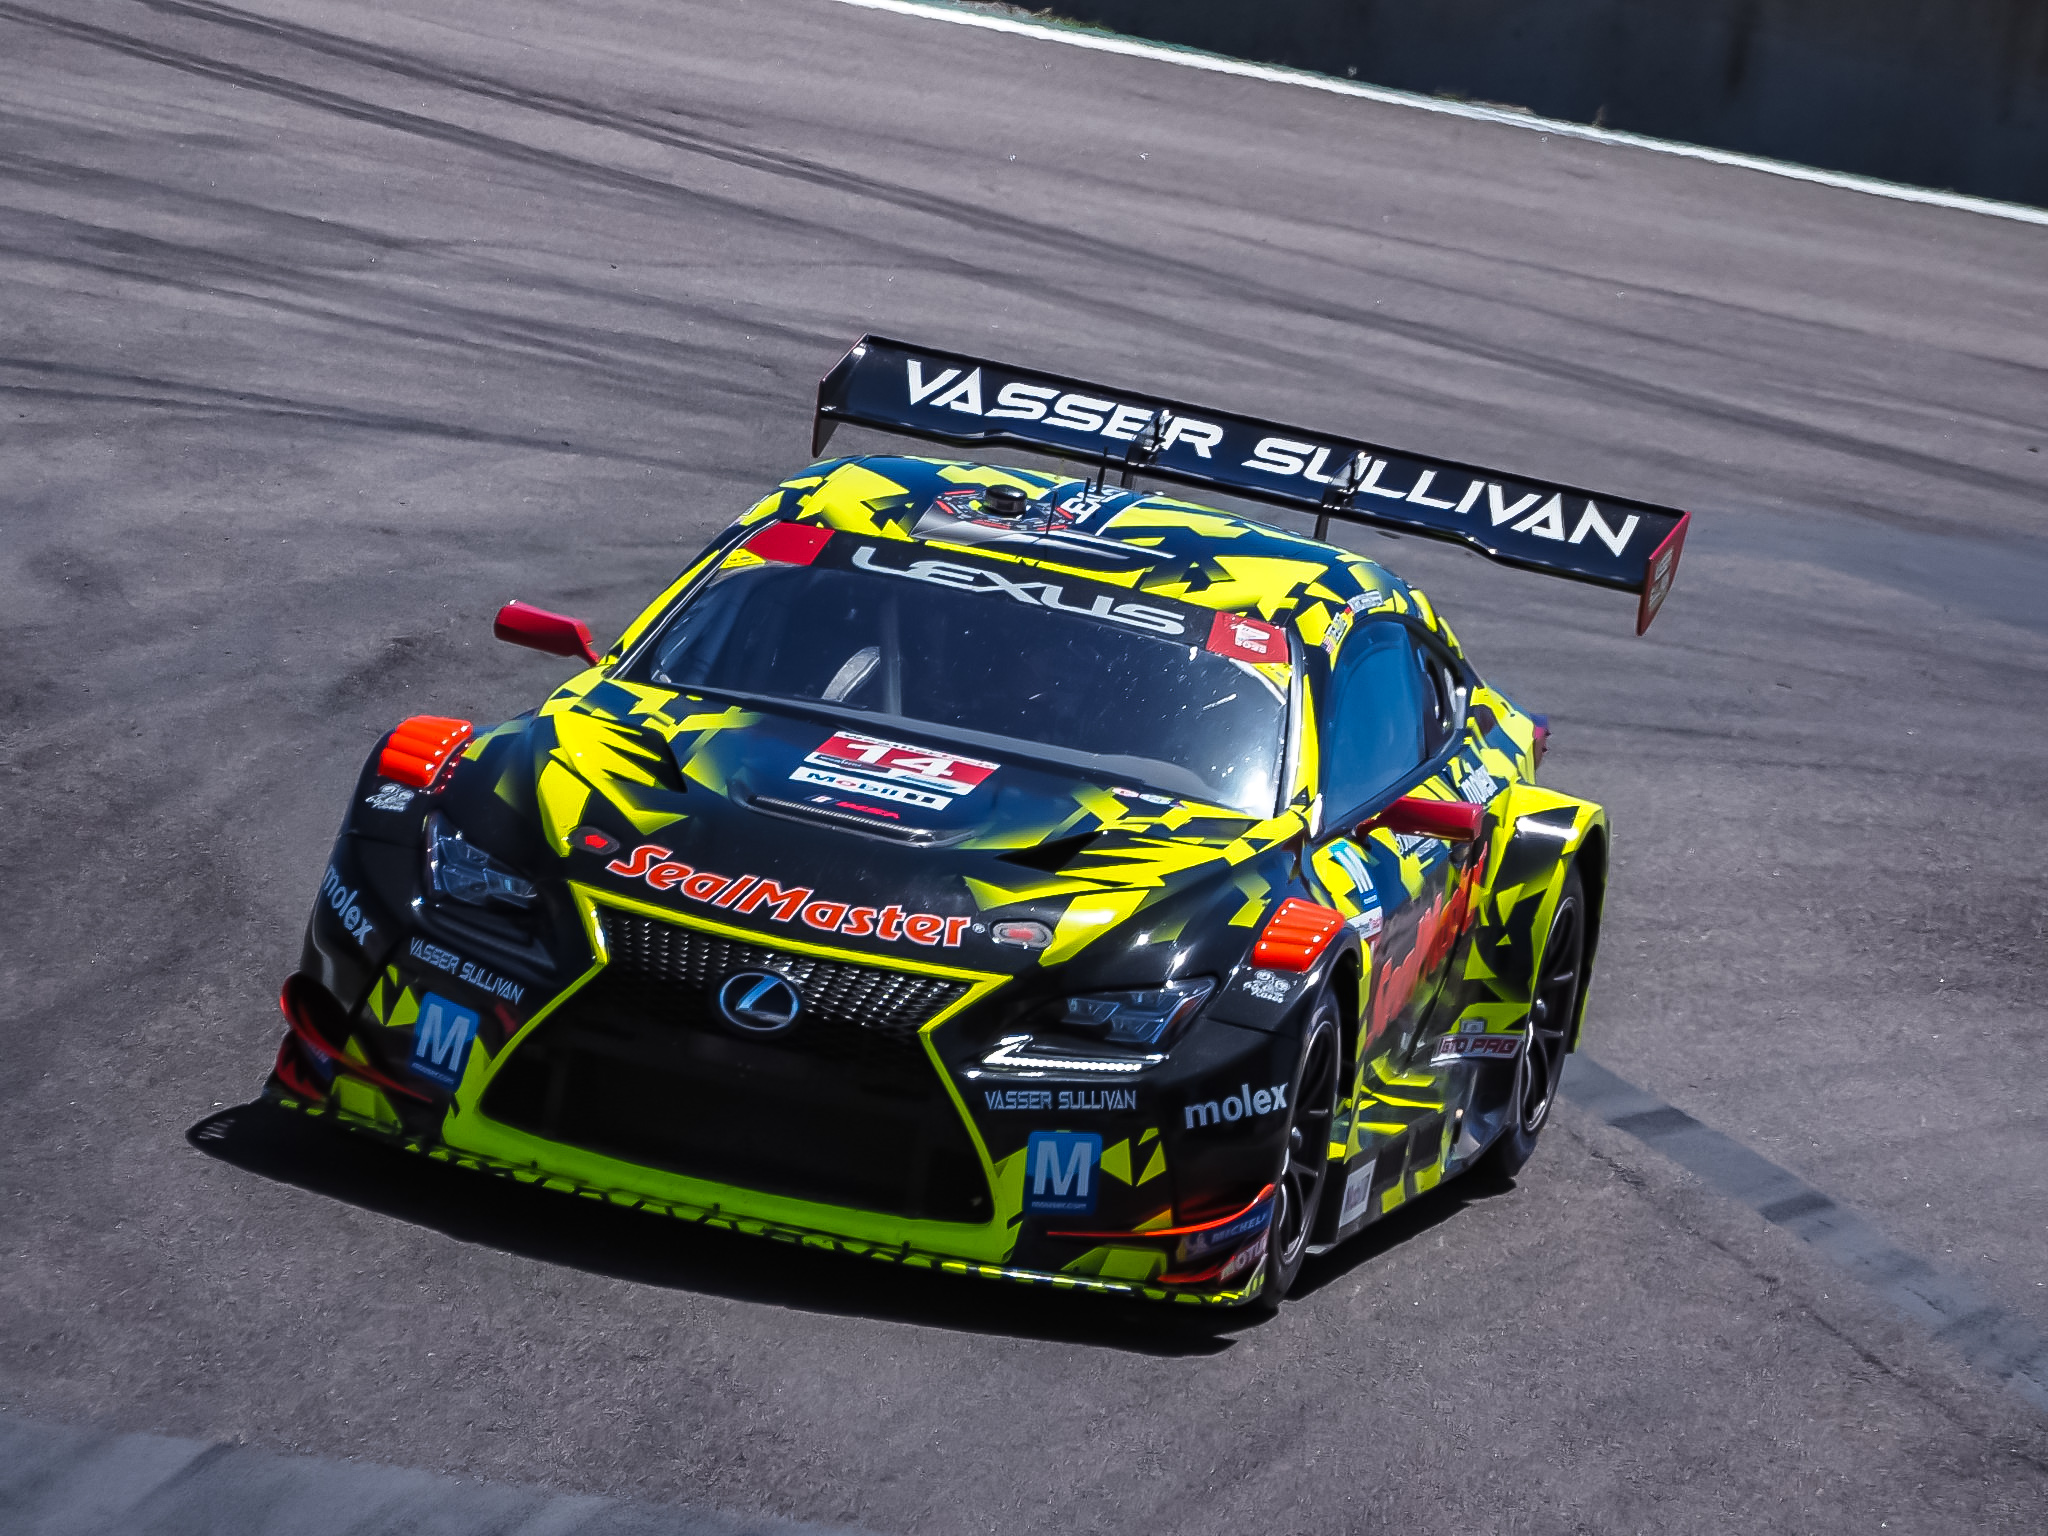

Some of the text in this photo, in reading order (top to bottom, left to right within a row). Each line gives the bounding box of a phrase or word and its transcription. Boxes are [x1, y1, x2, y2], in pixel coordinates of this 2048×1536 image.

[906, 359, 1640, 557] VASSER SULLIVAN
[851, 546, 1186, 635] LEXUS
[806, 772, 899, 796] Mobil
[846, 742, 954, 777] 14
[323, 864, 373, 946] molex
[606, 844, 970, 948] SealMaster
[409, 937, 525, 1006] VASSER SULLIVAN
[416, 1003, 471, 1073] M
[985, 1089, 1137, 1111] VASSER SULLIVAN
[1184, 1082, 1289, 1130] molex
[1033, 1140, 1092, 1197] M
